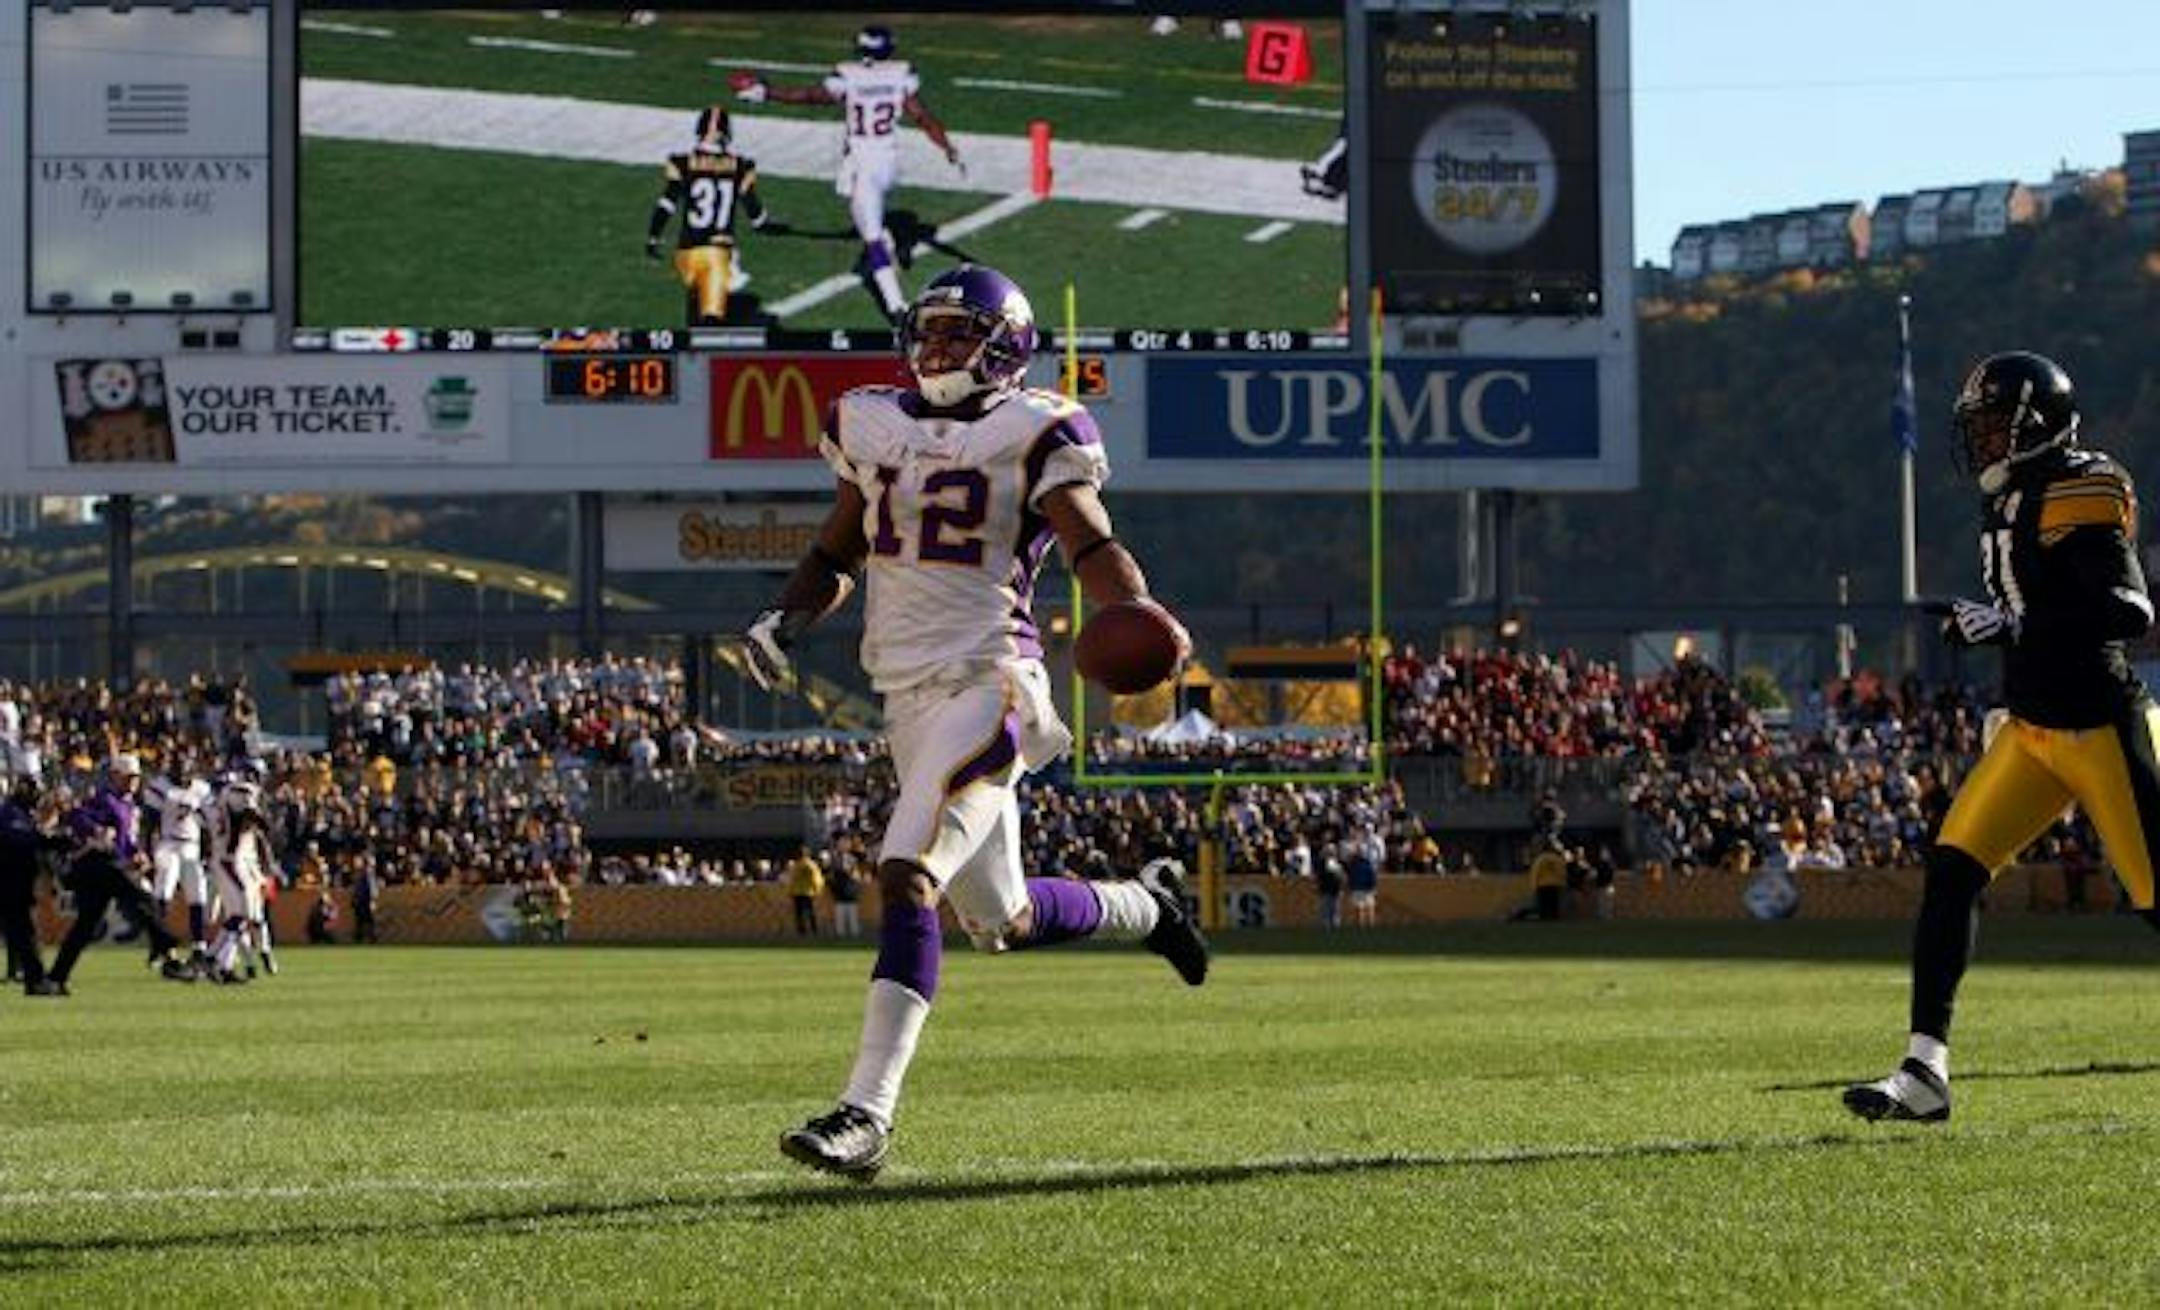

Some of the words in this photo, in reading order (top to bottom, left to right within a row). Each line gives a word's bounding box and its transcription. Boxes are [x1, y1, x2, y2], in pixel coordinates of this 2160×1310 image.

[1257, 32, 1290, 76] G
[854, 102, 895, 136] 12
[98, 162, 252, 181] AIRWAYS
[1433, 151, 1538, 183] Steelers
[687, 178, 735, 230] 31
[447, 330, 475, 350] 20
[649, 330, 674, 349] 10
[1131, 330, 1168, 350] Qtr
[1176, 330, 1193, 349] 4
[1246, 330, 1292, 350] 6:10
[584, 360, 664, 396] 6:10
[176, 385, 275, 409] YOUR
[284, 385, 396, 408] TEAM.
[1215, 369, 1533, 447] UPMC
[181, 410, 258, 434] OUR
[269, 410, 402, 433] TICKET.
[873, 464, 989, 565] 12
